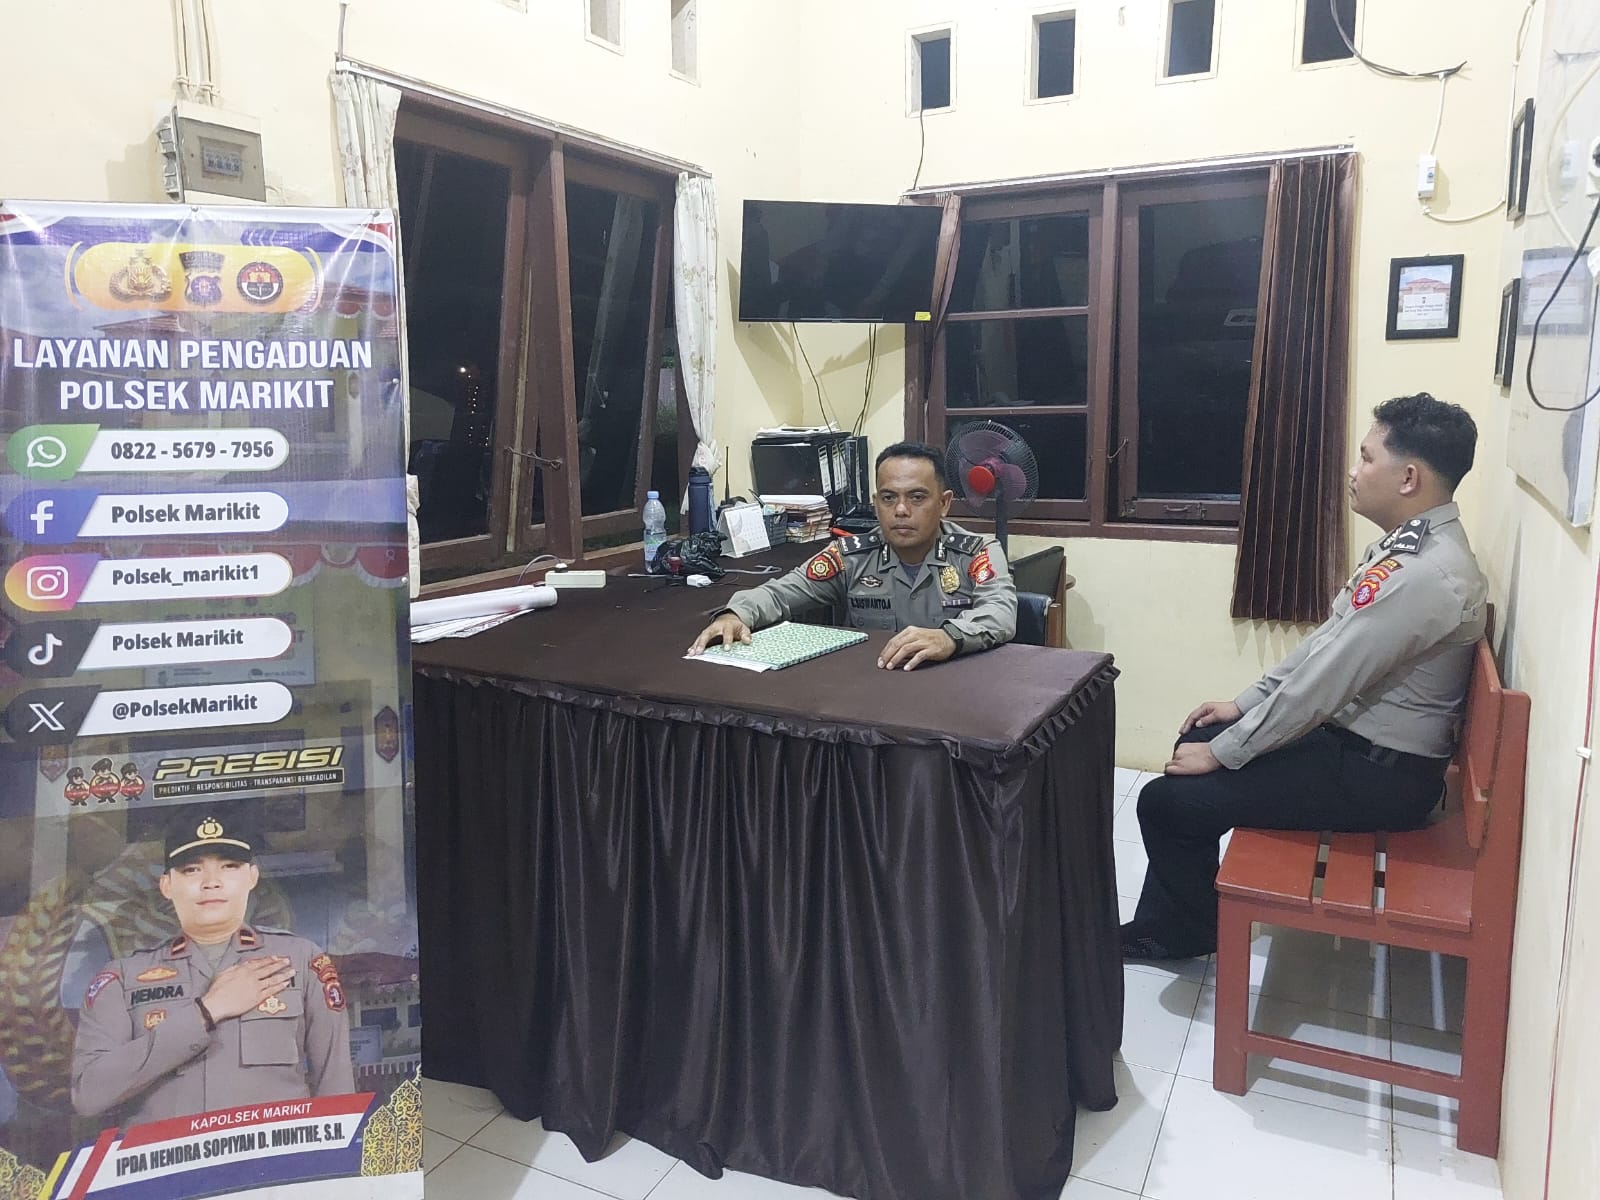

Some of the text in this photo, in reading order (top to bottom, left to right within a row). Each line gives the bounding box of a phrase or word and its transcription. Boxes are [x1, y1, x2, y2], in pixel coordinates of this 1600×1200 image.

[13, 338, 373, 369] LAYANAN PENGADUAN
[60, 379, 334, 410] POLSEK MARIKIT
[110, 442, 157, 460] 0822
[172, 441, 216, 459] 5679
[231, 440, 274, 458] 7956
[111, 502, 261, 524] Polsek Marikit
[112, 564, 259, 587] Polsek_marikit1
[112, 628, 244, 651] Polsek Marikit
[112, 694, 259, 721] @PolsekMarikit
[153, 745, 346, 781] PRESISI
[196, 779, 248, 792] RESPONSIBILITAS
[253, 775, 298, 788] TRANSPARANSI
[297, 772, 337, 784] BERKEADILAN
[130, 984, 184, 1006] HENDRA
[190, 1102, 313, 1132] KAPOLSEK MARIKIT
[116, 1122, 346, 1177] IPDA HENDRA SOPIYAN D. MUNTHE, S.H.
